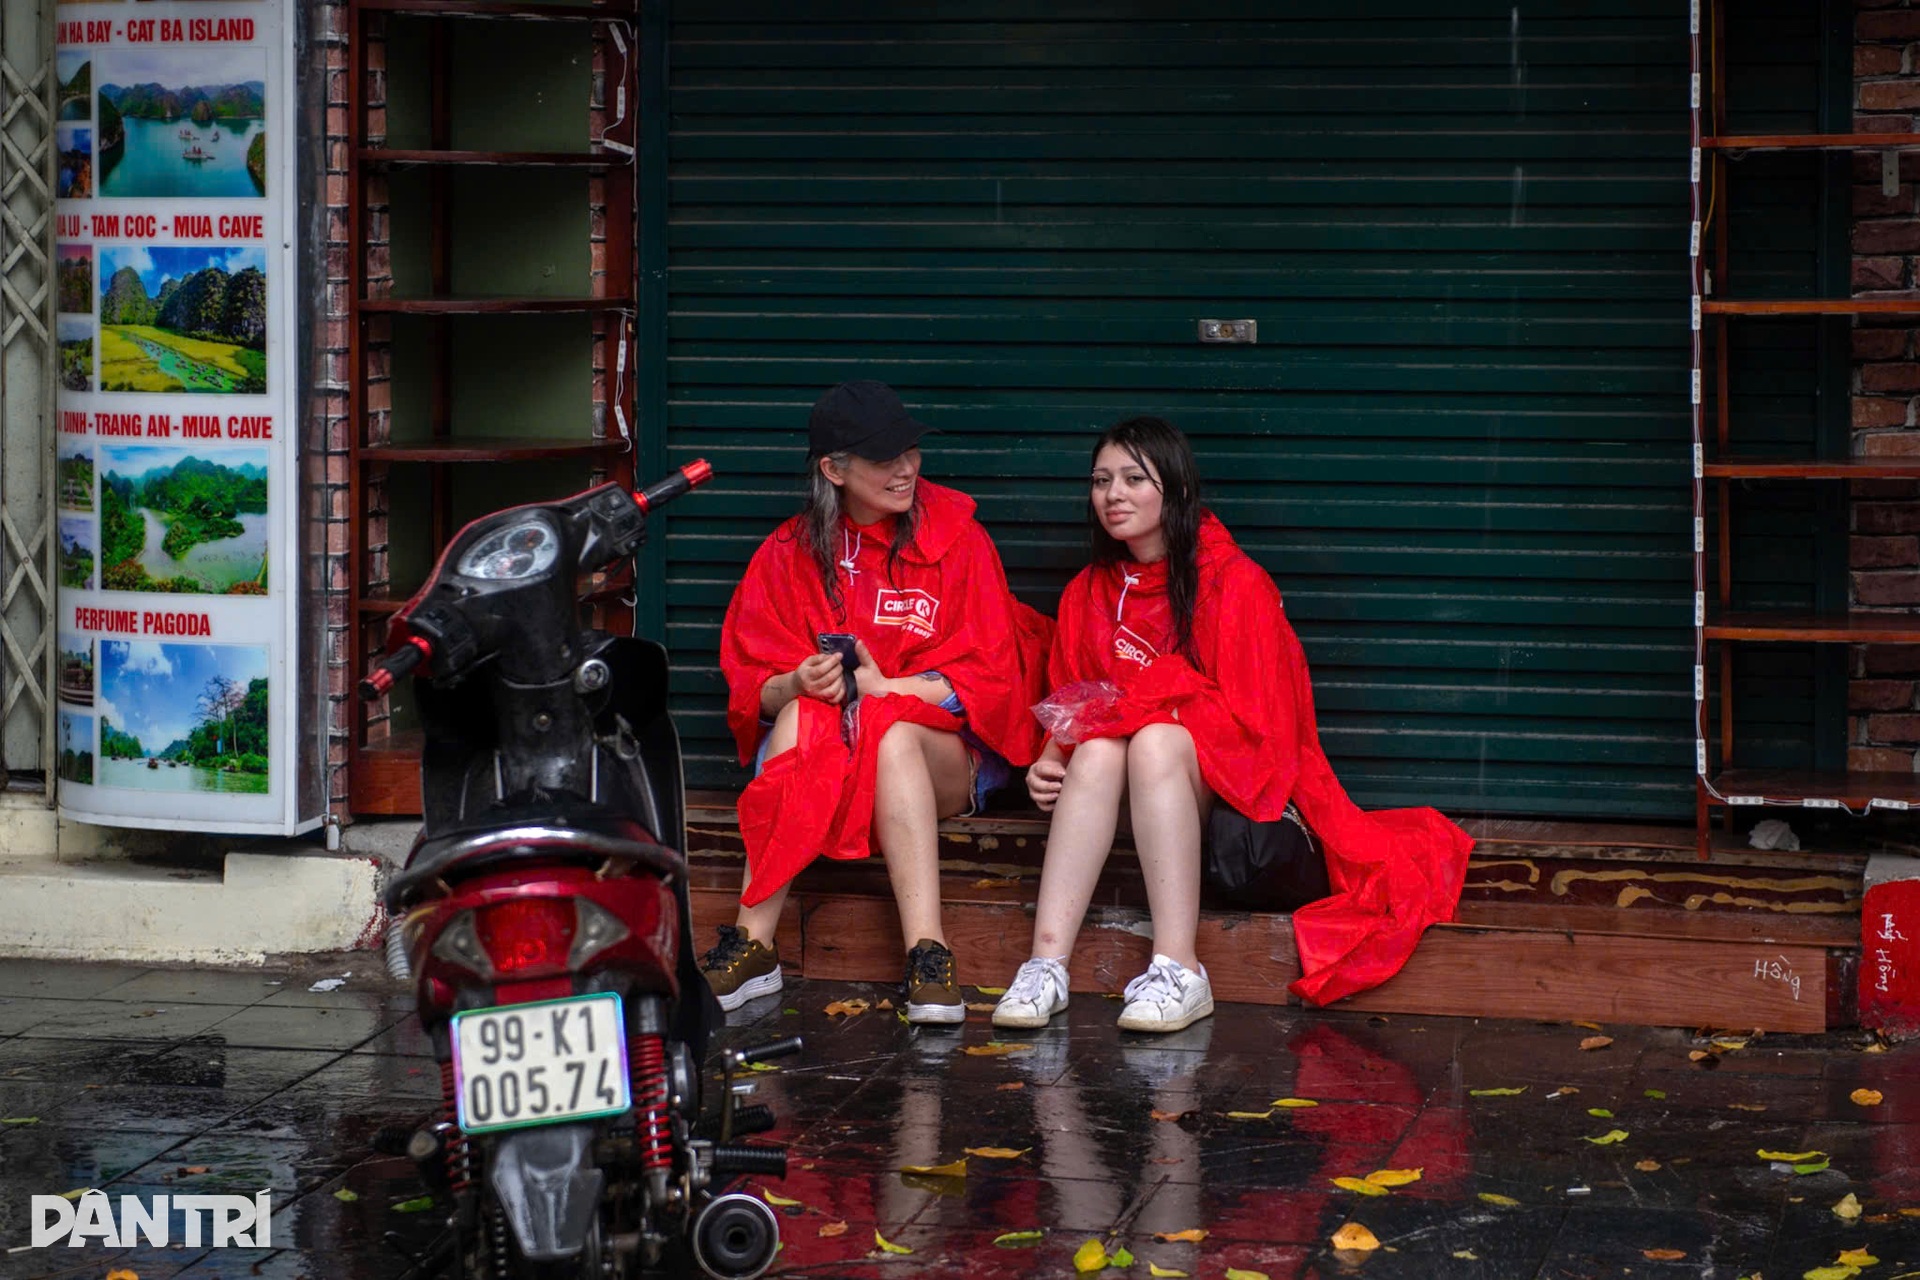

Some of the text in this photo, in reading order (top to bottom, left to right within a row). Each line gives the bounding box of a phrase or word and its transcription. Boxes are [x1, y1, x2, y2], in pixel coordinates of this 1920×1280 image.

[69, 21, 83, 43] HA
[87, 20, 112, 43] BAY
[127, 19, 156, 42] CAT
[160, 18, 184, 42] BA
[189, 18, 255, 42] ISLAND
[68, 215, 80, 238] LU
[91, 215, 119, 238] TAM
[124, 215, 157, 238] COC
[174, 215, 214, 239] MUA
[218, 215, 264, 239] CAVE
[63, 411, 87, 434] DINH
[95, 412, 142, 437] TRANG
[146, 414, 170, 438] AN
[182, 415, 222, 439] MUA
[227, 415, 273, 440] CAVE
[75, 607, 212, 637] PERFUME PAGODA
[480, 1006, 596, 1065] 99-K1
[470, 1058, 616, 1122] 005.74
